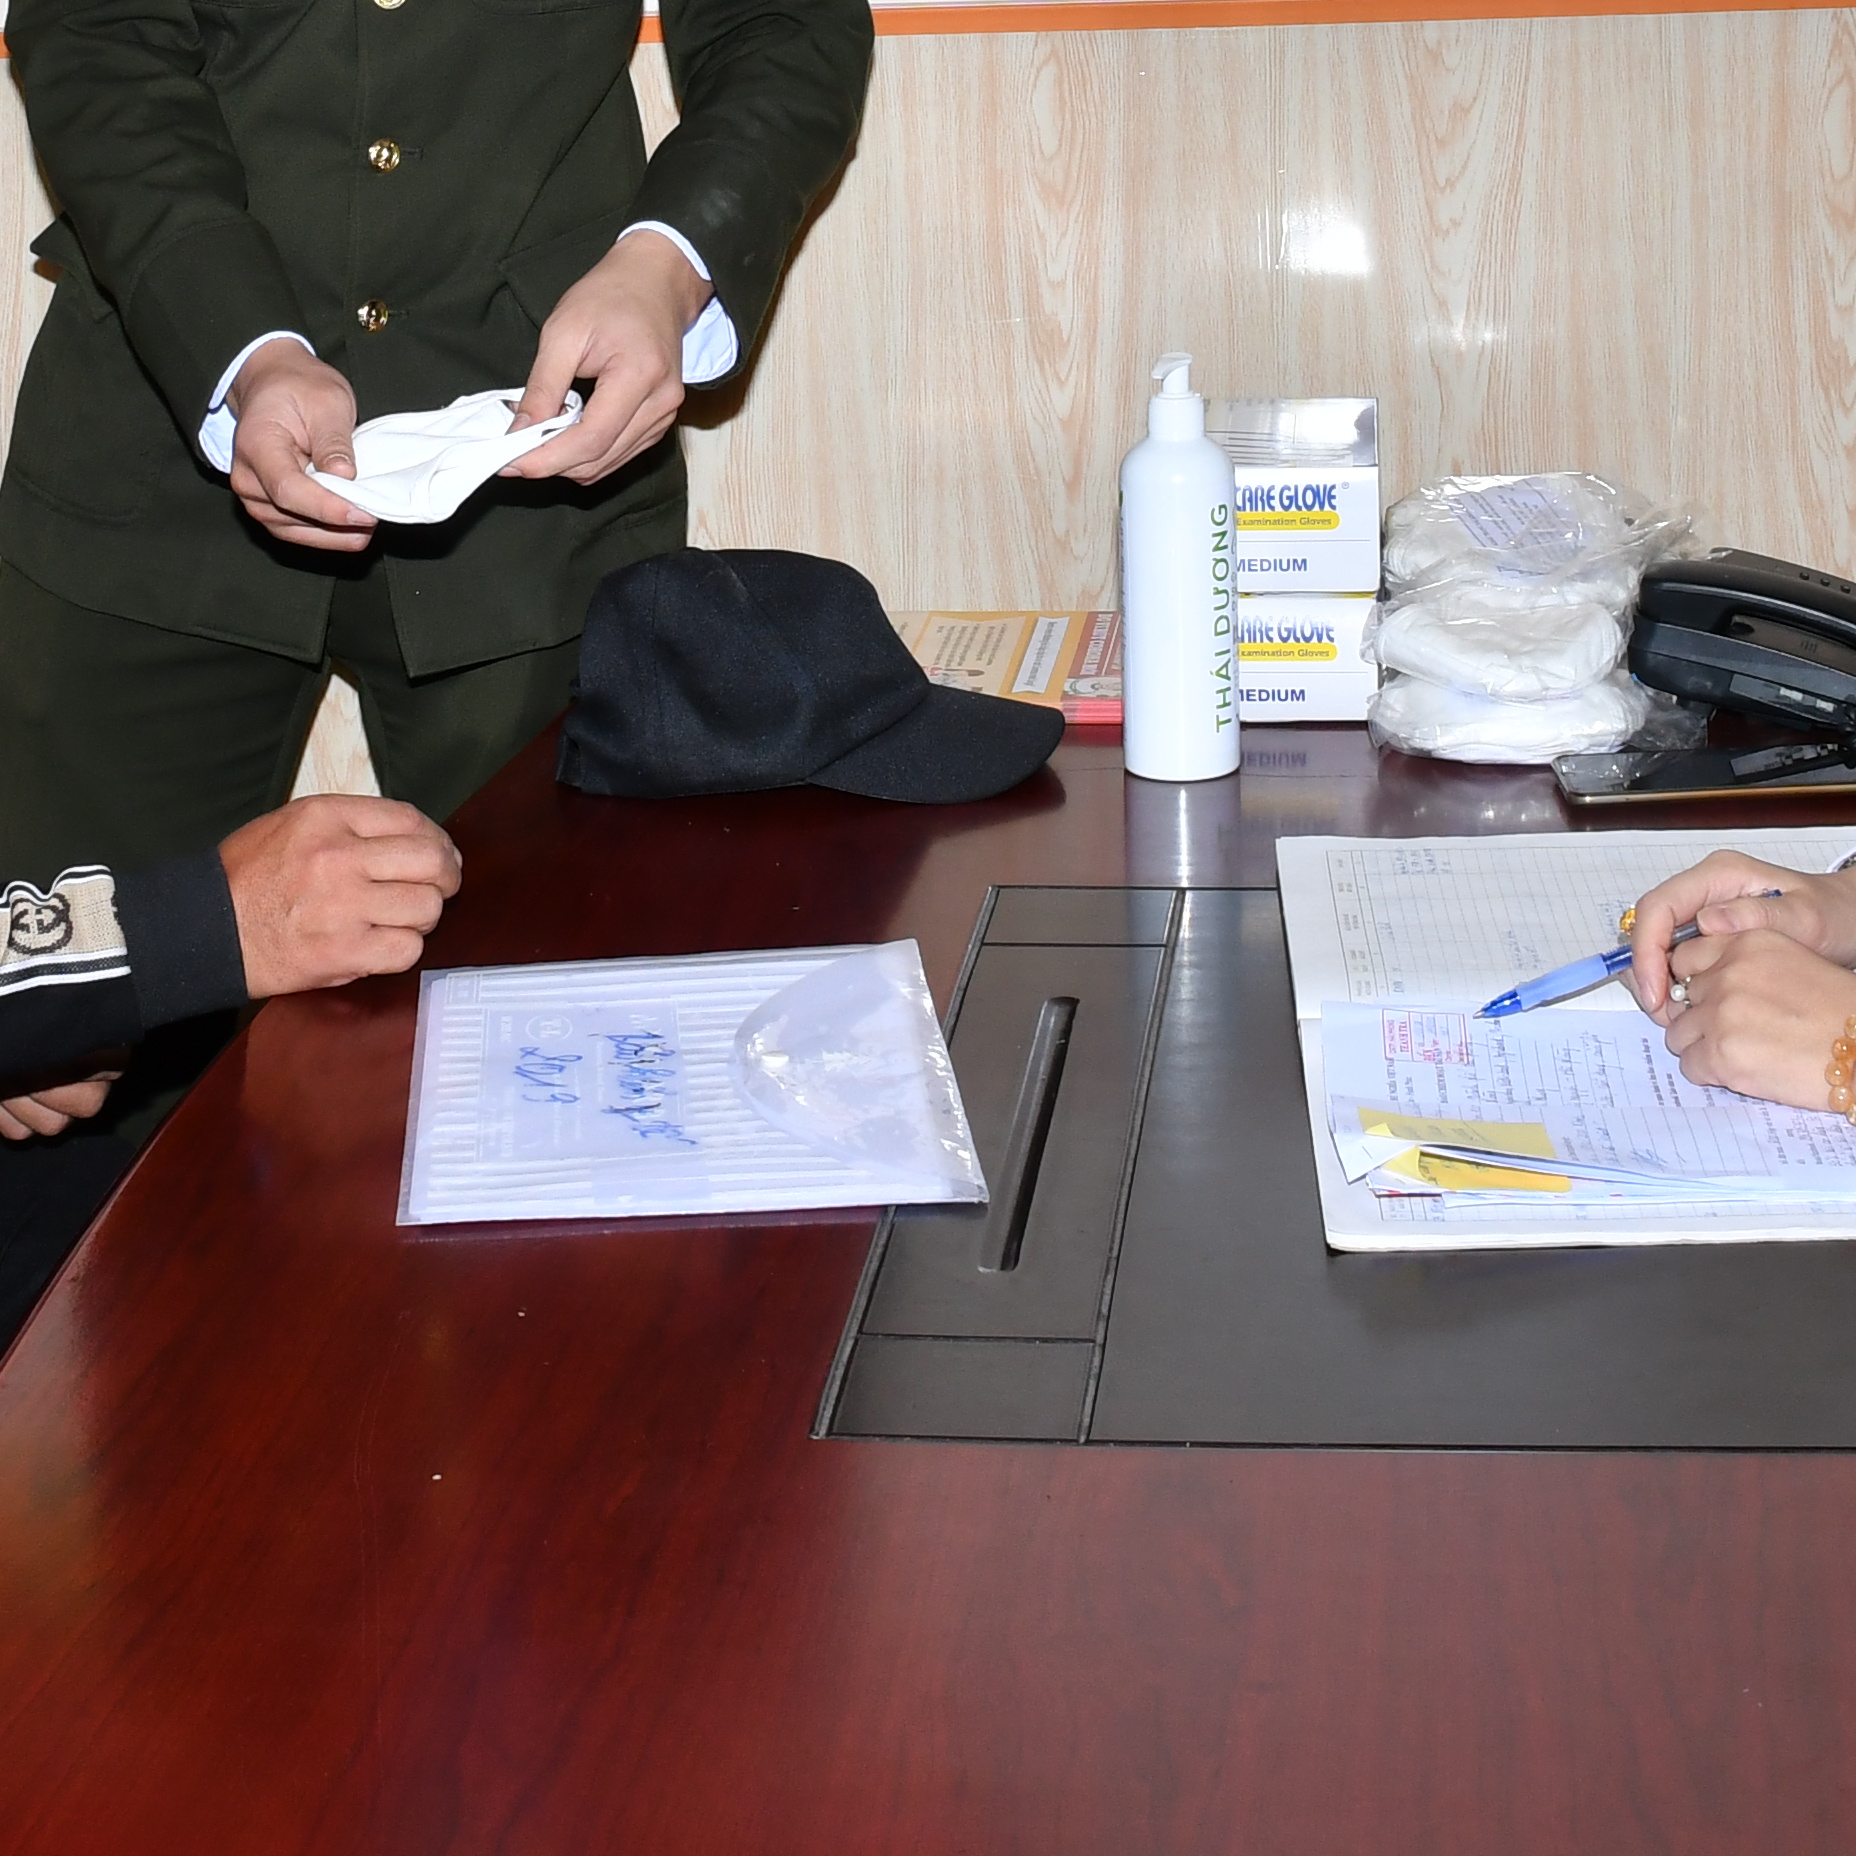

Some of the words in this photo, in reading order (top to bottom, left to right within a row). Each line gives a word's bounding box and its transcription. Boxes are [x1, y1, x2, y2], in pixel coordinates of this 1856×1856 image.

[1278, 483, 1337, 513] GLOVE
[1299, 516, 1332, 526] Gloves
[1210, 503, 1232, 637] DƯƠNG
[1240, 648, 1296, 658] xamination
[1209, 648, 1232, 733] THÁI
